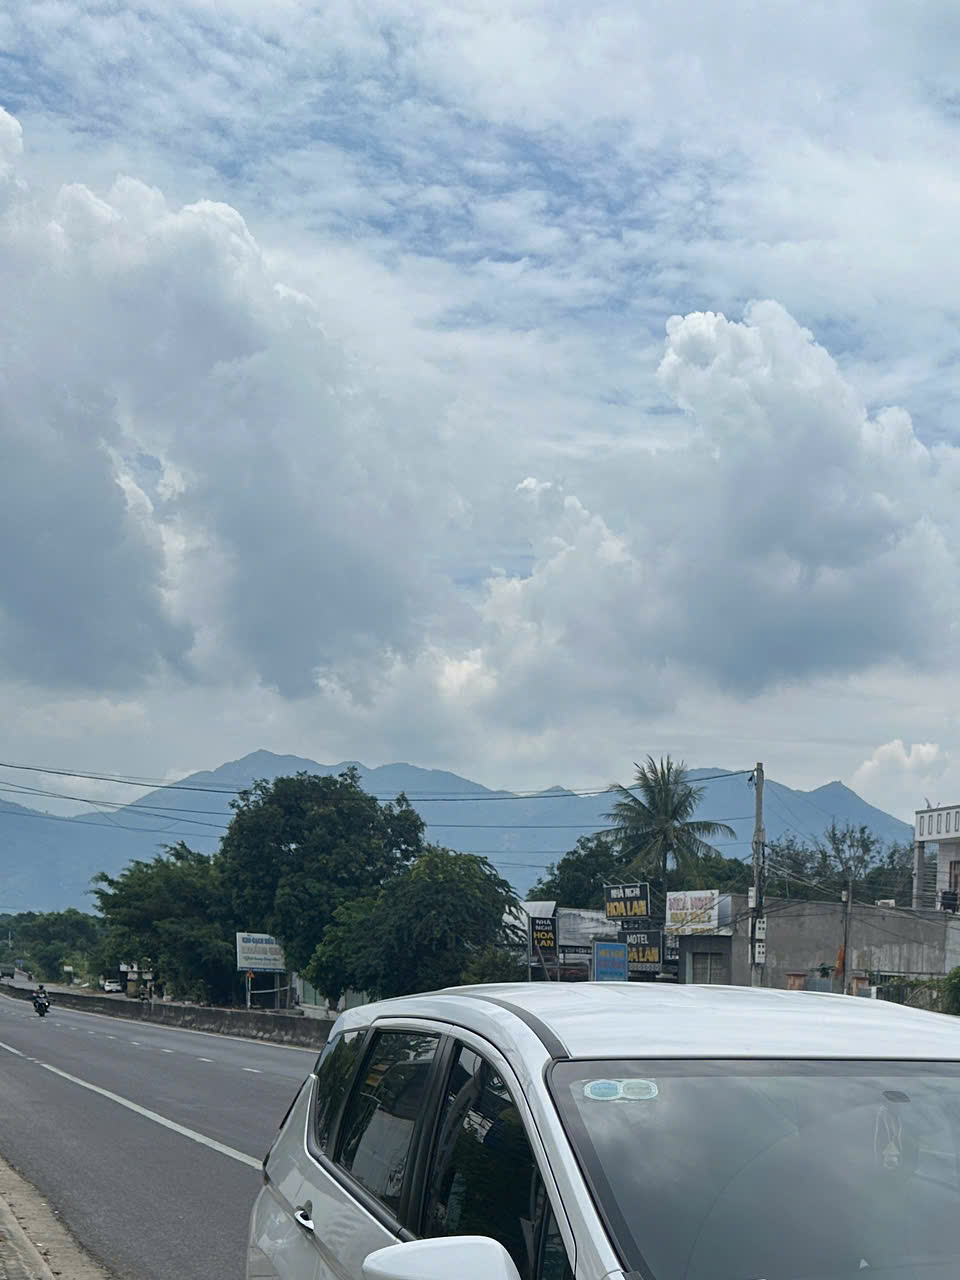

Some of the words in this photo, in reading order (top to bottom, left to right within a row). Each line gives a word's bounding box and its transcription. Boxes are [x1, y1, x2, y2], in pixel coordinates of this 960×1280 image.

[606, 901, 627, 917] HOA
[626, 900, 648, 915] LAN
[533, 931, 555, 939] HOA
[626, 934, 649, 945] MOTEL
[534, 939, 554, 947] LAN
[639, 946, 659, 962] LAN
